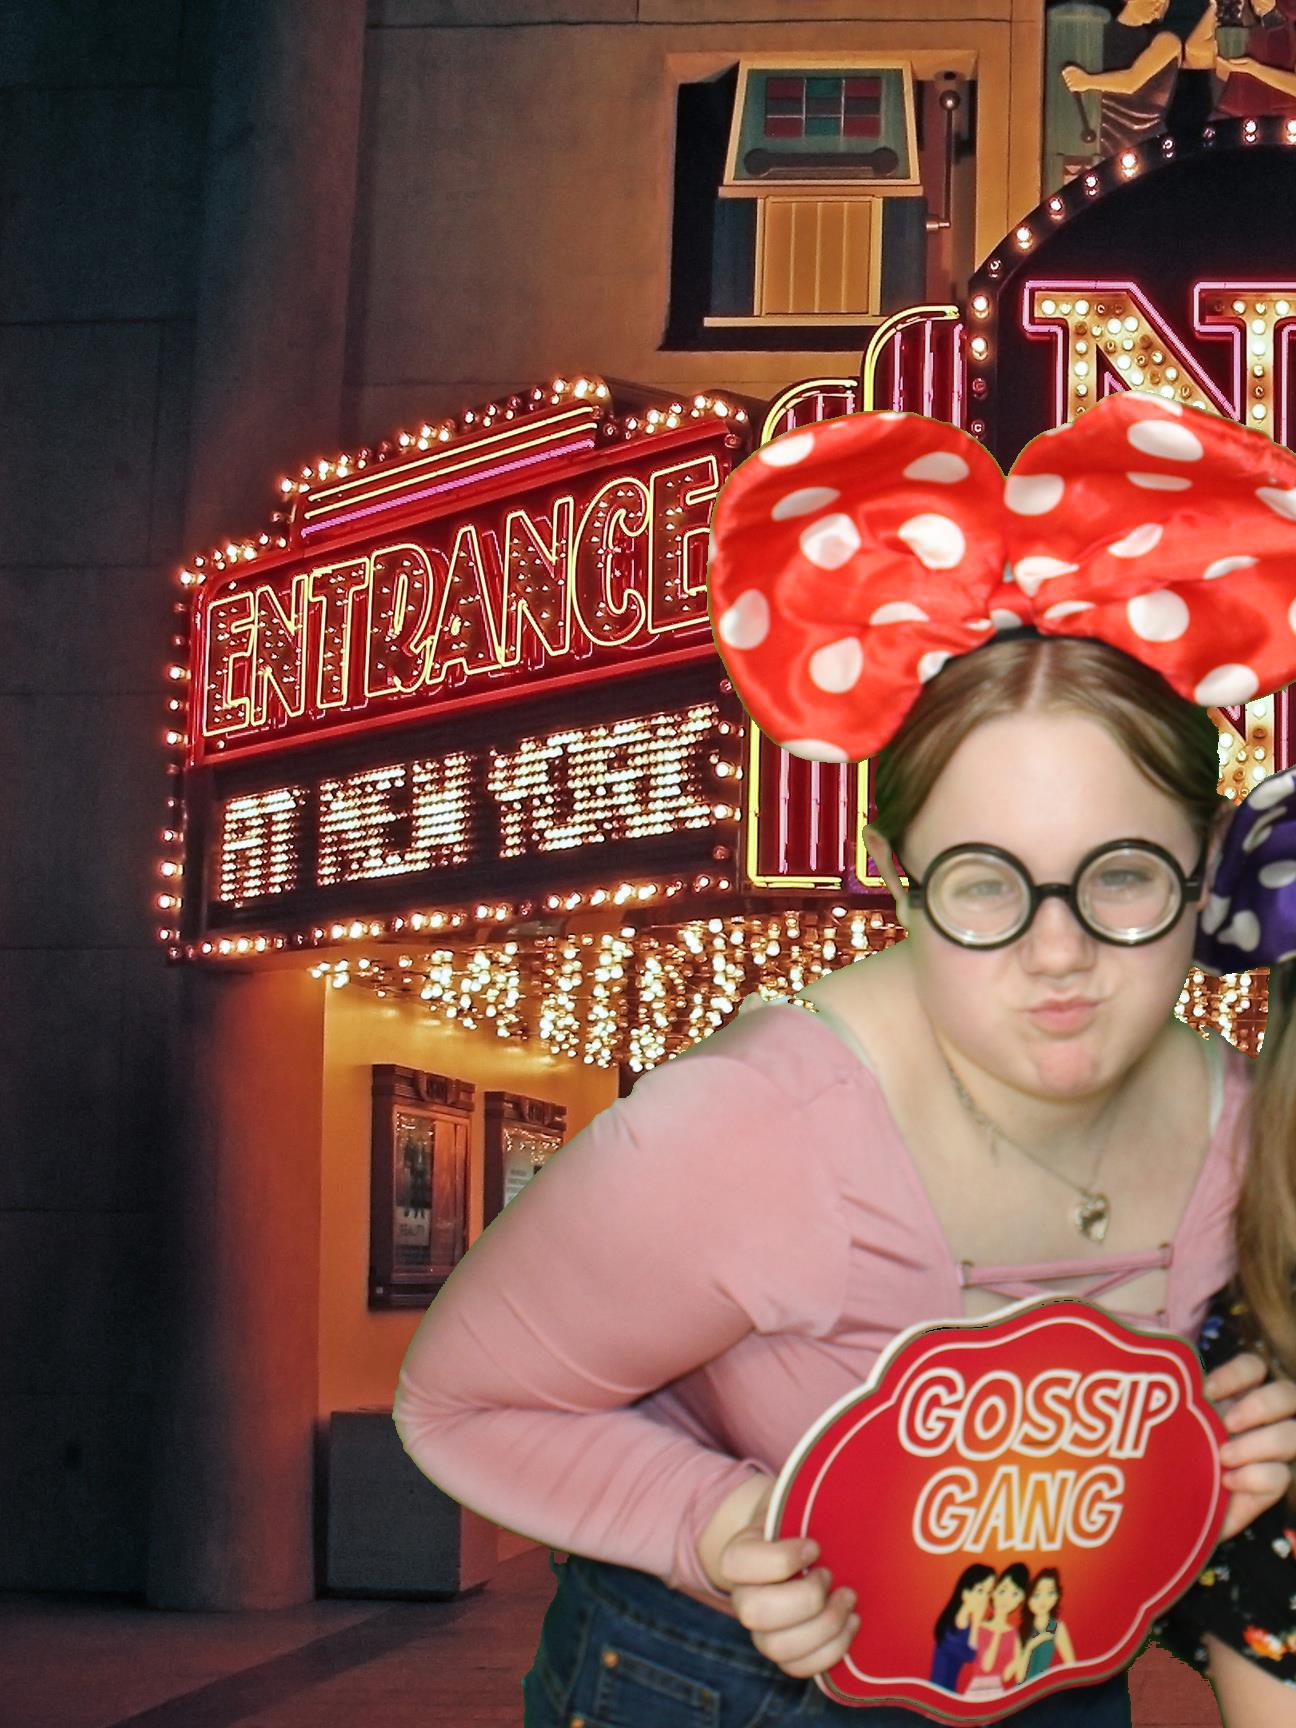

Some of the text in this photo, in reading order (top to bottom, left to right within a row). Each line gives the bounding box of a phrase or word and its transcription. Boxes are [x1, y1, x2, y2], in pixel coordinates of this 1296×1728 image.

[201, 454, 719, 740] ENTRANCE
[898, 1367, 1180, 1461] GOSSIP
[912, 1465, 1125, 1555] GANG
